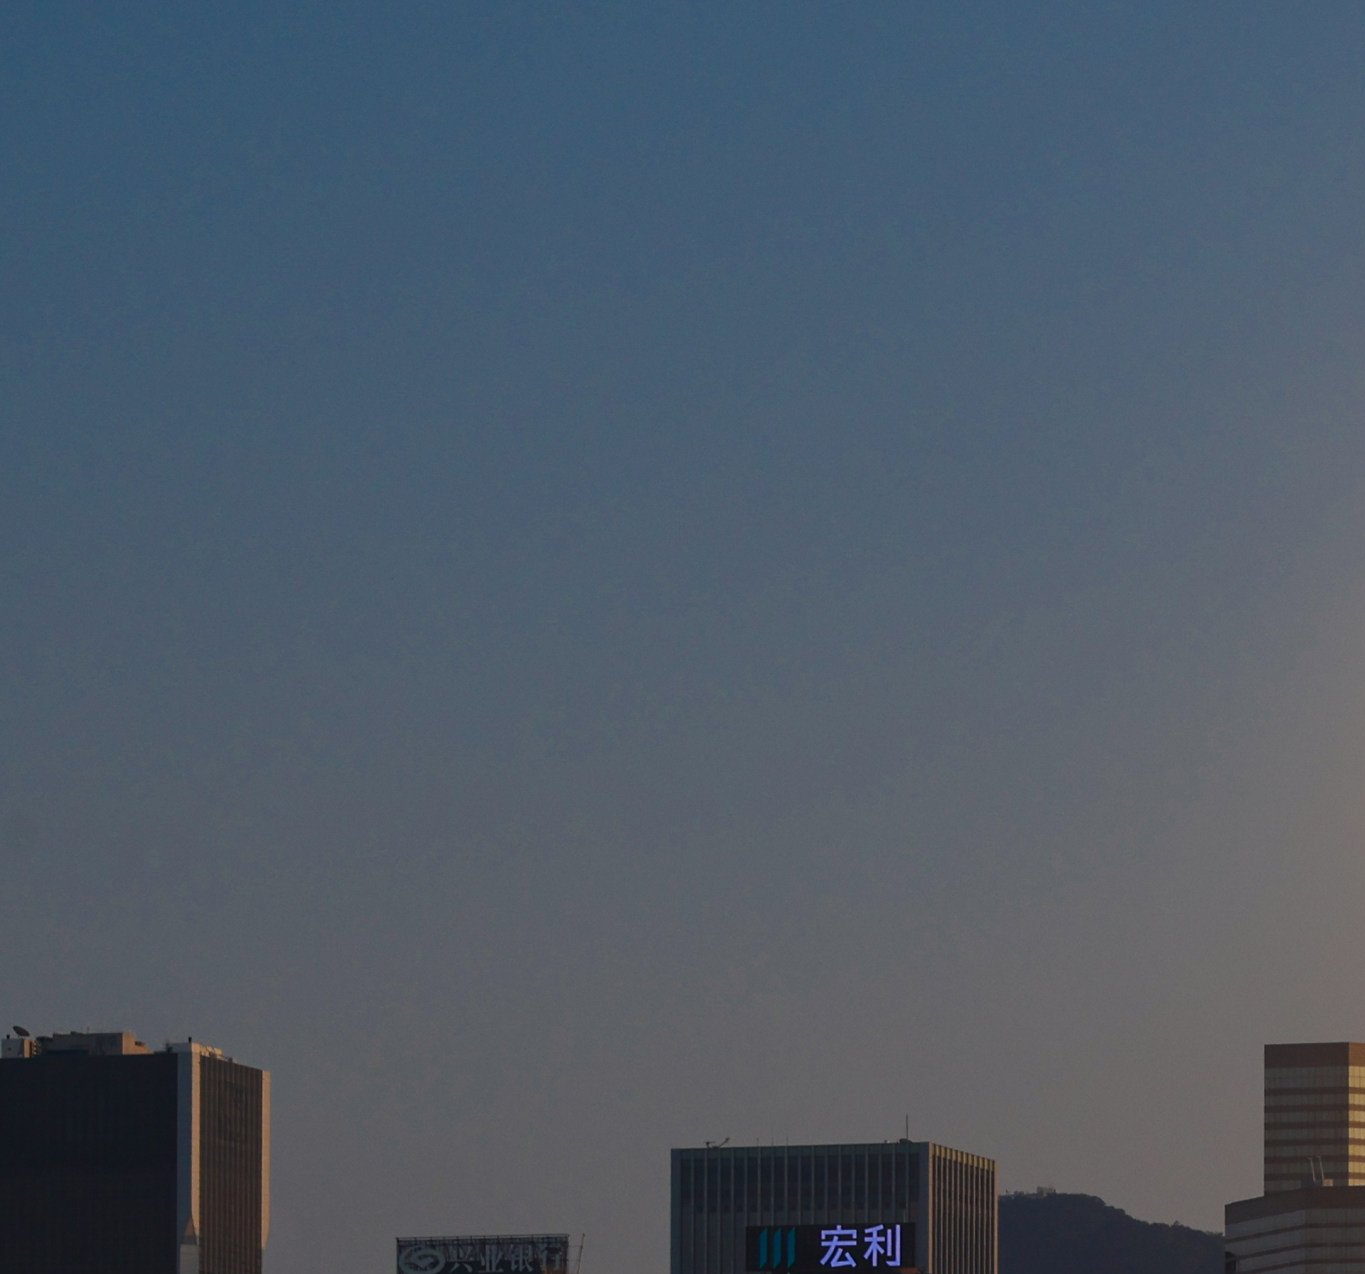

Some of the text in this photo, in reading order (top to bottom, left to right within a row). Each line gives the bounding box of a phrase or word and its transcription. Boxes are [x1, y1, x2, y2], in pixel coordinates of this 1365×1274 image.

[447, 1242, 563, 1274] 兴业银行
[819, 1223, 901, 1268] 宏利
